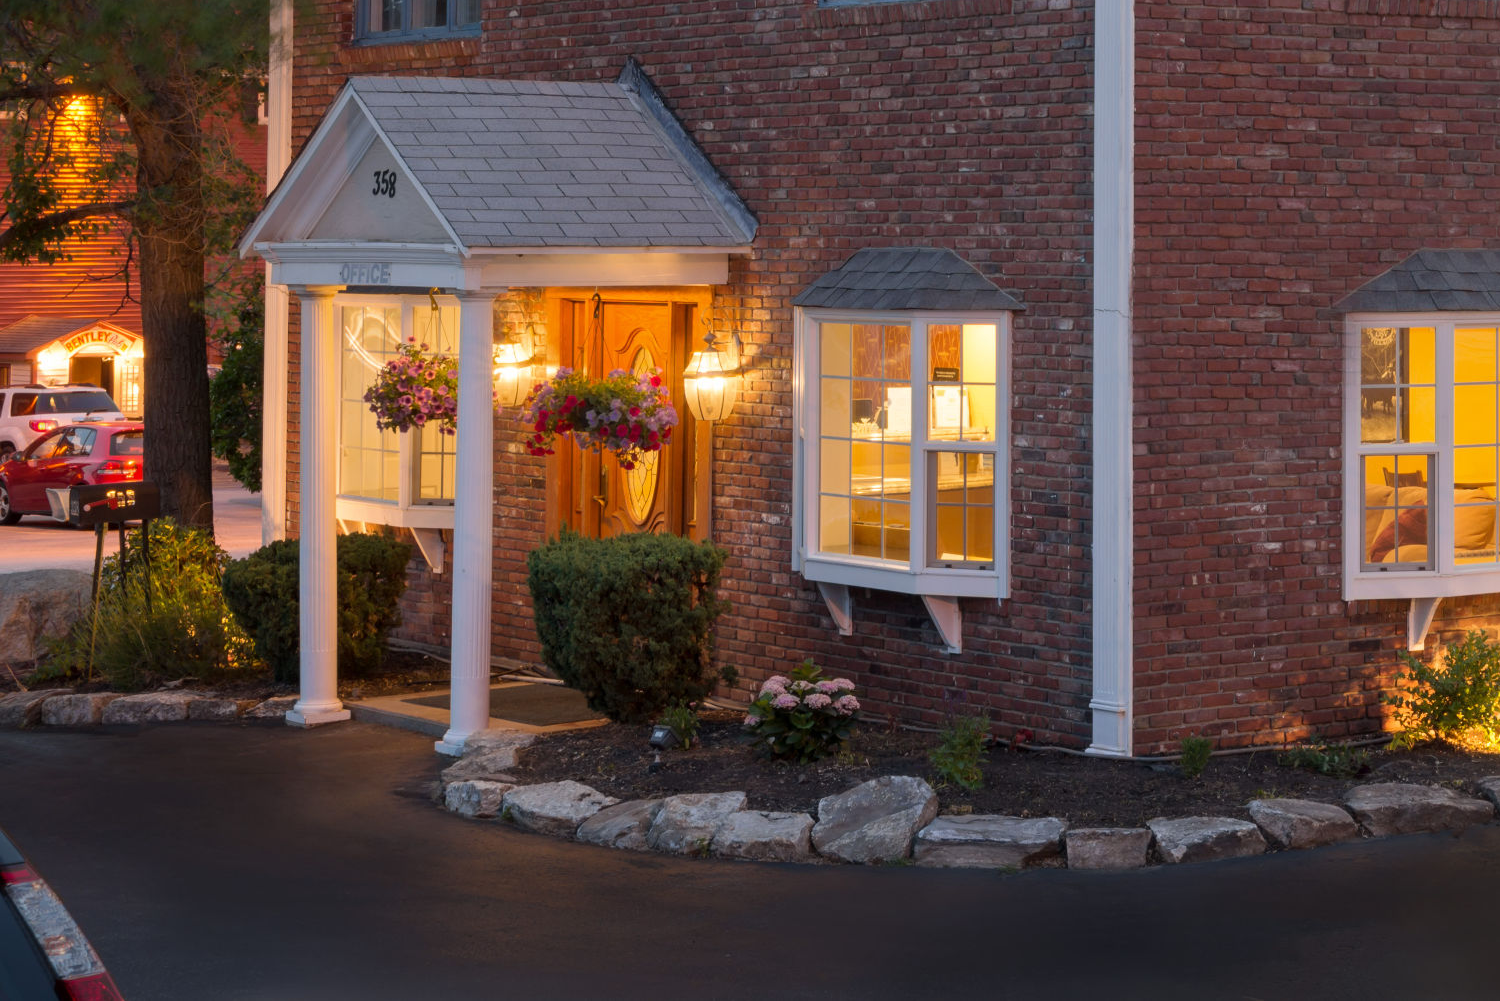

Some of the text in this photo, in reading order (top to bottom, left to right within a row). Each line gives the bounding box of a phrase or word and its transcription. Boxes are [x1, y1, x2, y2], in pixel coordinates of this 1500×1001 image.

[372, 169, 397, 198] 358
[341, 263, 390, 284] OFFICE
[65, 331, 112, 353] BENTLEY
